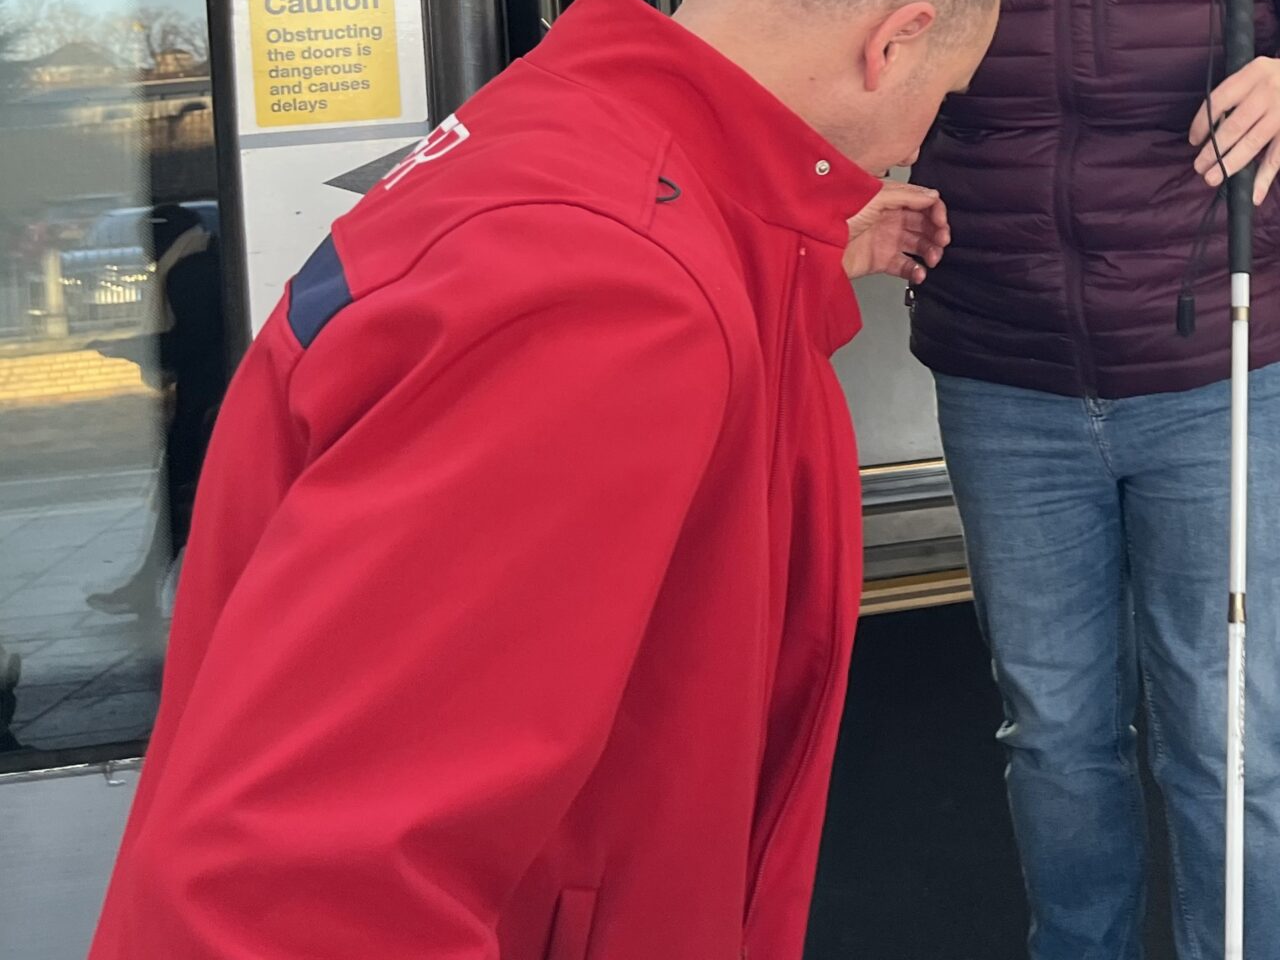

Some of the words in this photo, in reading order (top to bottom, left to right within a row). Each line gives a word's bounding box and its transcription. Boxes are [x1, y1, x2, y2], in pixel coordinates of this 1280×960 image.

[266, 24, 383, 44] Obstructing
[267, 48, 296, 62] the
[300, 45, 352, 60] doors
[356, 42, 372, 56] is
[269, 81, 303, 96] and
[307, 78, 371, 94] causes
[271, 99, 329, 113] delays
